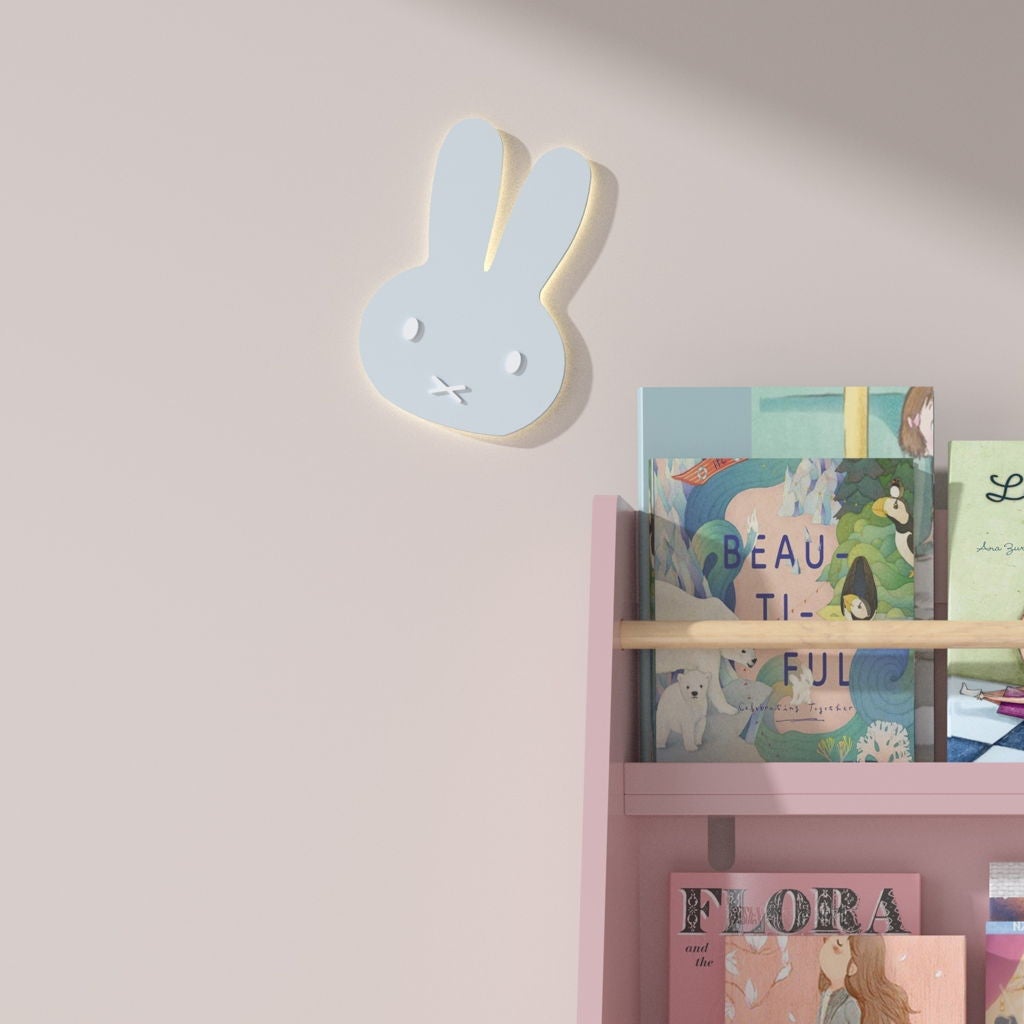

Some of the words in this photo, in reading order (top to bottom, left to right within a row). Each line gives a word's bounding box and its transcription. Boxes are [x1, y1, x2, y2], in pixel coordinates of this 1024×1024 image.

[723, 534, 849, 569] BEAU-
[976, 540, 1003, 553] Ana
[755, 593, 814, 621] TI-
[783, 652, 850, 687] FUL
[677, 887, 912, 935] FLORA
[684, 942, 710, 954] and
[694, 956, 715, 968] the
